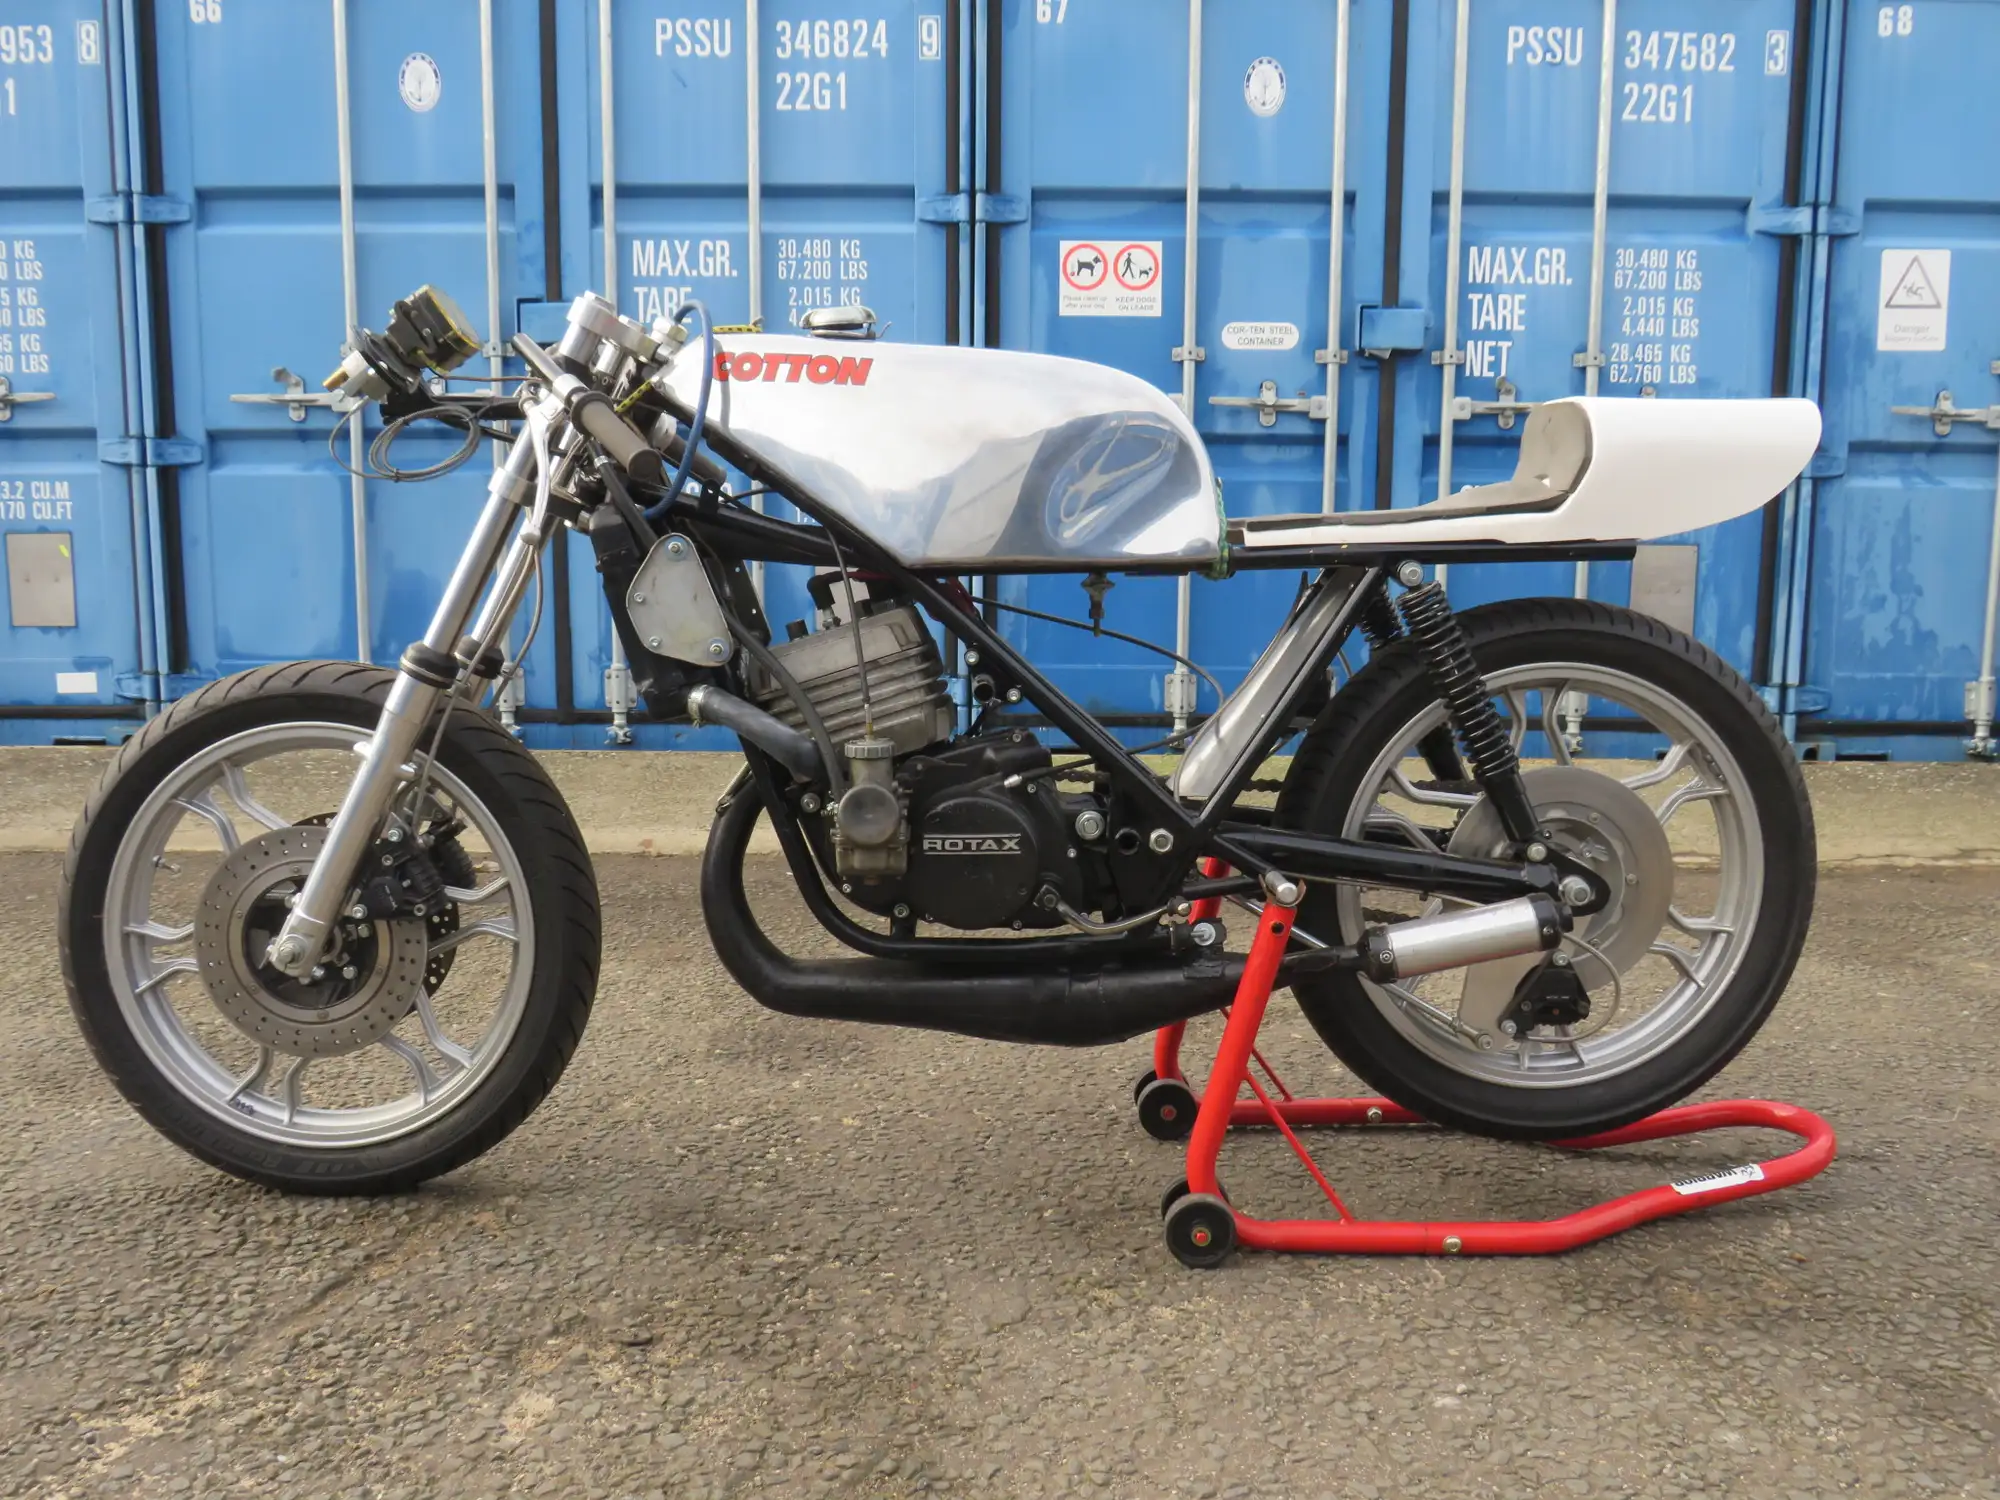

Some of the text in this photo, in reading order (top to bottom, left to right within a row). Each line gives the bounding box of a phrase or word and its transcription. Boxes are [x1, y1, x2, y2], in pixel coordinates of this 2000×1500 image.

[189, 0, 222, 23] 66
[1036, 0, 1068, 24] 67
[1878, 6, 1913, 36] 68
[0, 24, 97, 64] 953 8
[654, 18, 938, 59] PSSU 346824 9
[1507, 25, 1786, 73] PSSU 347582 3
[0, 78, 16, 115] 1
[776, 72, 847, 111] 22G1
[1622, 83, 1693, 123] 22G1
[14, 240, 35, 260] KG
[632, 239, 738, 278] MAX.GR.
[840, 239, 861, 259] KG
[15, 260, 43, 281] LBS
[840, 260, 868, 281] LBS
[1468, 246, 1573, 286] MAX.GR.
[1676, 249, 1697, 270] KG
[1674, 270, 1703, 291] LBS
[17, 287, 38, 307] KG
[840, 286, 861, 306] KG
[0, 308, 46, 328] 0 LBS
[1468, 293, 1527, 332] TARE
[1673, 296, 1695, 318] KG
[1269, 326, 1293, 335] STEEL
[1672, 318, 1700, 338] LBS
[20, 333, 41, 353] KG
[1237, 337, 1285, 346] CONTAINER
[21, 353, 49, 373] LBS
[713, 352, 874, 386] COTTON
[1465, 340, 1512, 377] NET
[1670, 345, 1691, 364] KG
[1669, 364, 1697, 384] LBS
[31, 481, 70, 500] CU.M
[32, 501, 73, 520] CU.FT
[922, 838, 1021, 851] ROTAX
